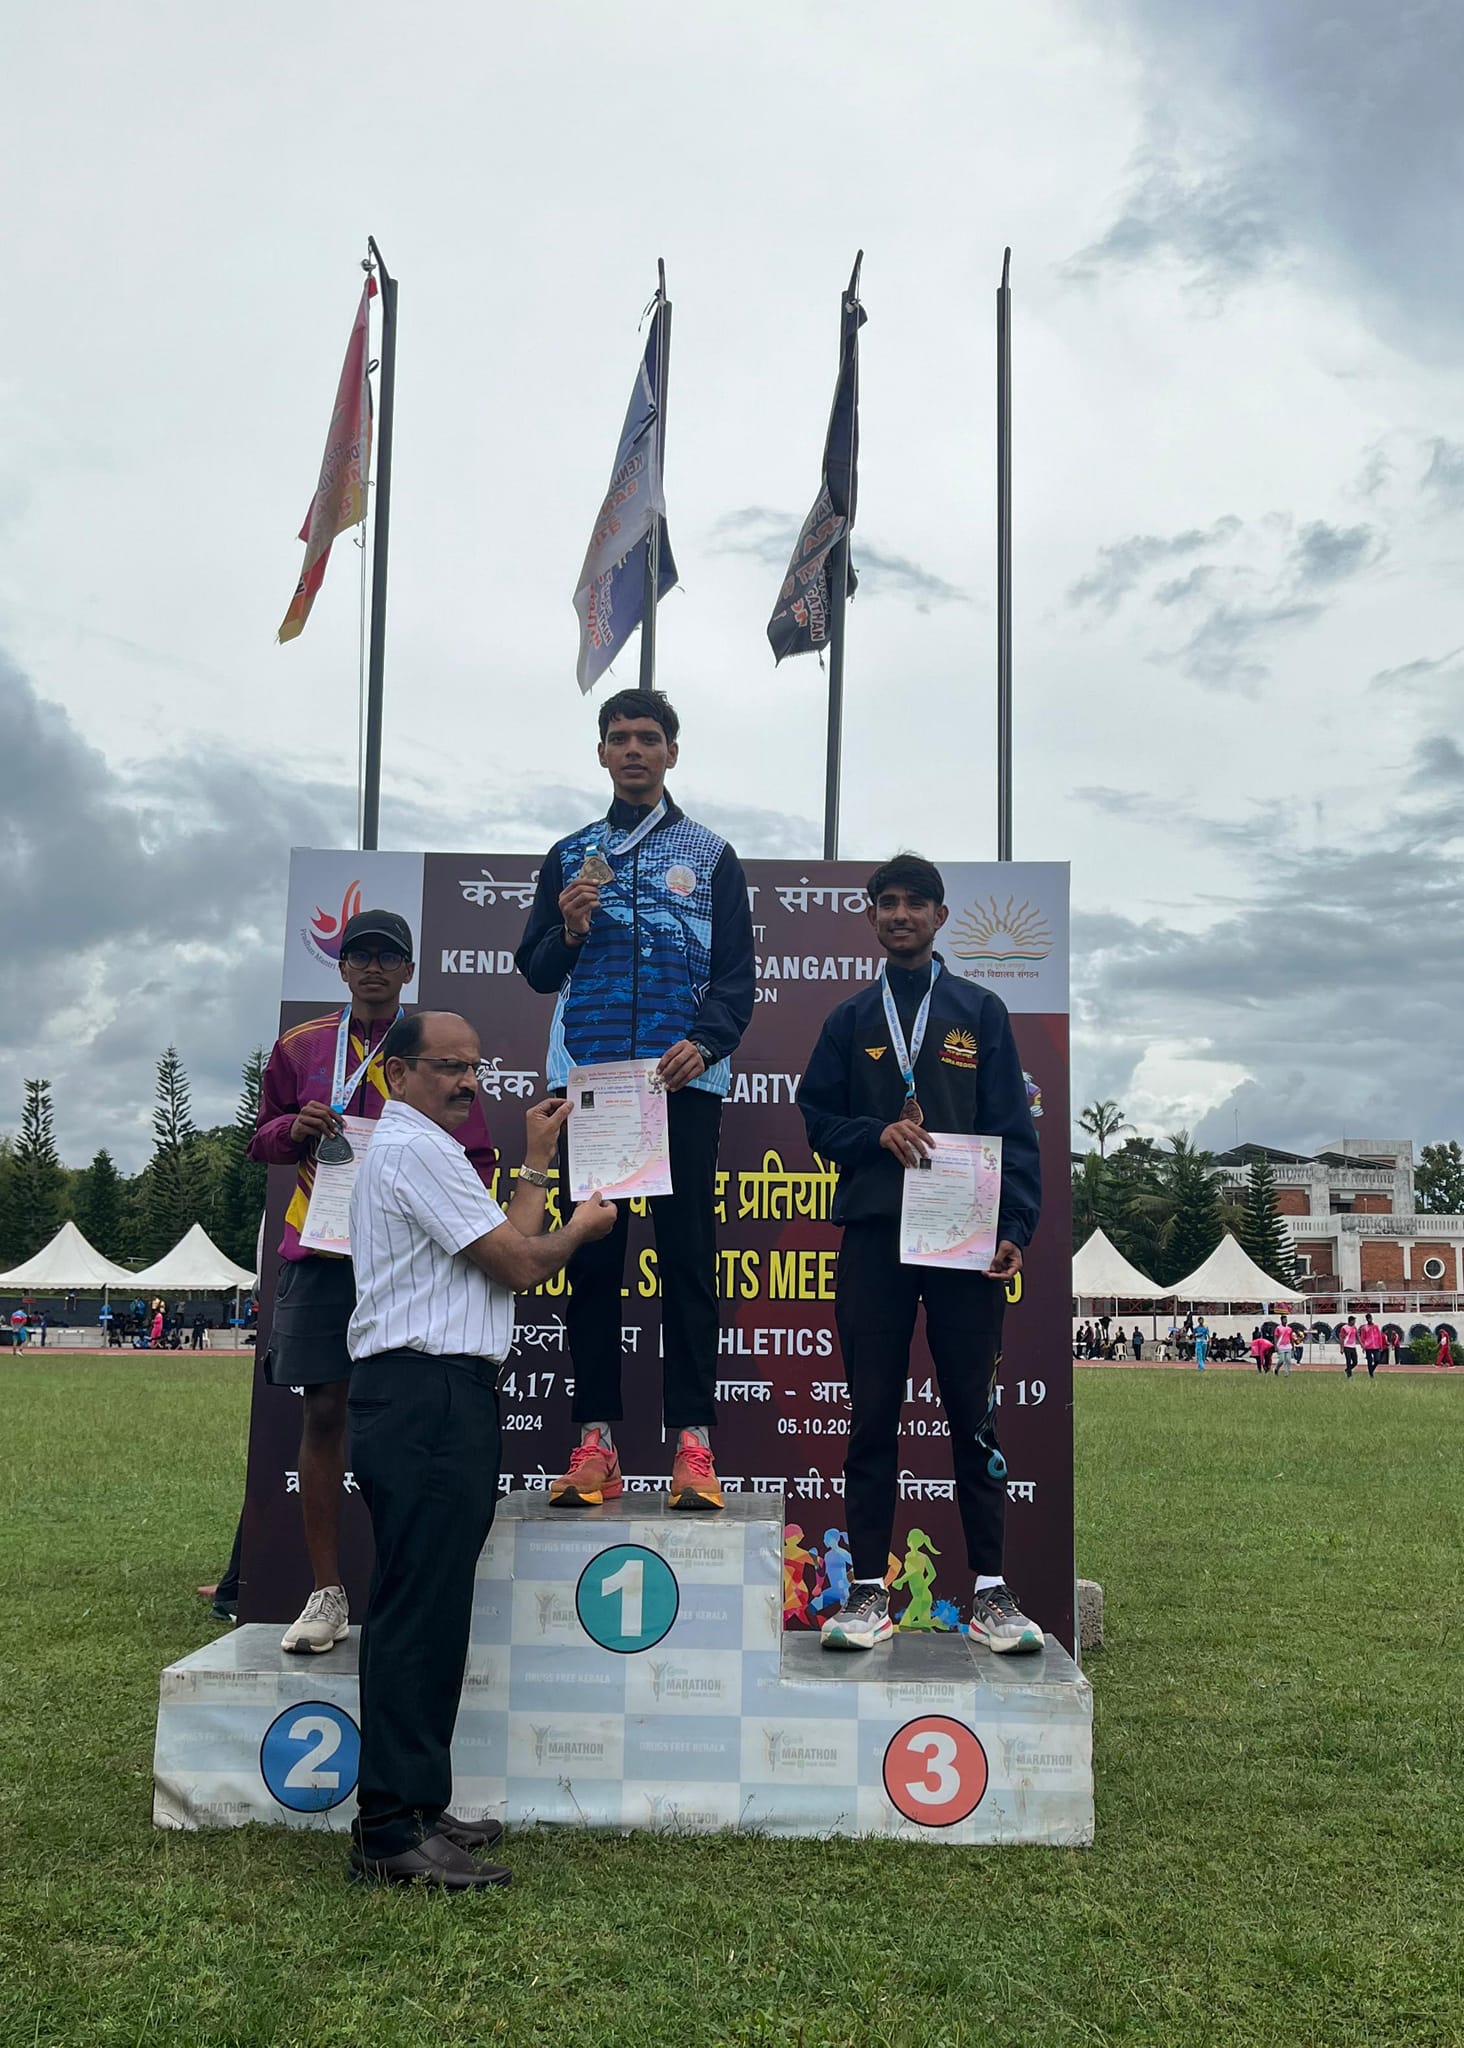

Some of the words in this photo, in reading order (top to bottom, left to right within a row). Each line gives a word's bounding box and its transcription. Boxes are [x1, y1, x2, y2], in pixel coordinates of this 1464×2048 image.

[806, 585, 825, 642] GATHAN
[775, 877, 875, 913] संगठ
[441, 949, 522, 974] KEND
[738, 1149, 840, 1220] प्रतियो
[769, 1251, 839, 1300] MEE
[717, 1327, 833, 1357] HLETICS
[499, 1370, 556, 1402] 4,17
[903, 1377, 942, 1408] 14,
[1016, 1379, 1047, 1406] 19
[501, 1414, 543, 1431] .2024
[897, 1420, 951, 1437] .10.20
[601, 1559, 644, 1638] 1
[665, 1679, 721, 1691] MARATHON
[283, 1715, 342, 1789] 2
[548, 1742, 604, 1755] MARATHON
[781, 1748, 837, 1761] MARATHON
[1016, 1754, 1073, 1766] MARATHON
[905, 1731, 961, 1806] 3
